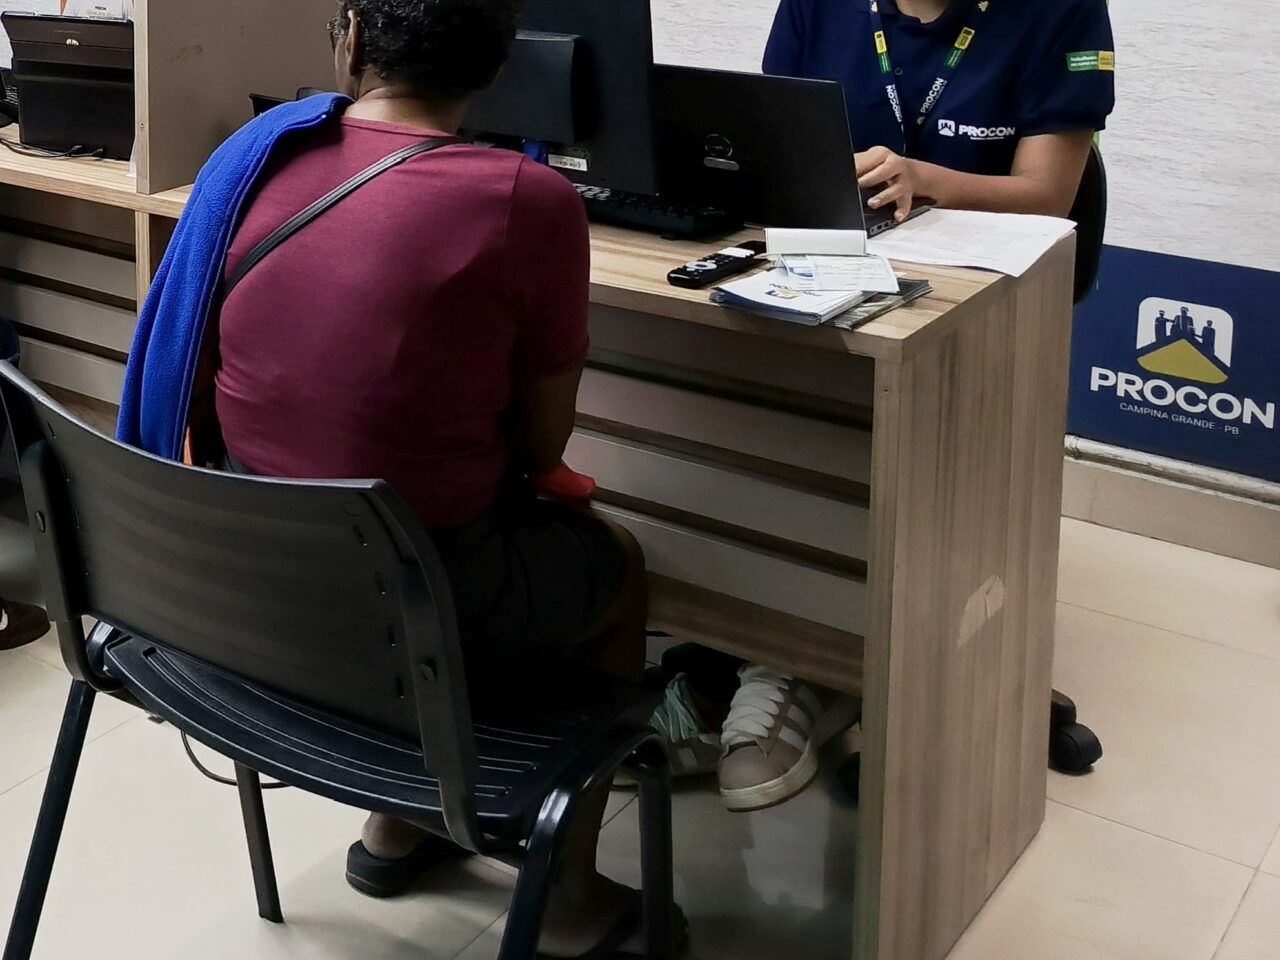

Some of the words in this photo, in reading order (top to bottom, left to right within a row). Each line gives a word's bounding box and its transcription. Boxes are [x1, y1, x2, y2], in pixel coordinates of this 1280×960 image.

[920, 77, 945, 113] PROCON
[958, 125, 1016, 137] PROCON
[1090, 366, 1276, 429] PROCON
[1119, 402, 1169, 420] CAMPINA
[1171, 413, 1216, 430] GRANDE
[1224, 424, 1240, 436] PB
